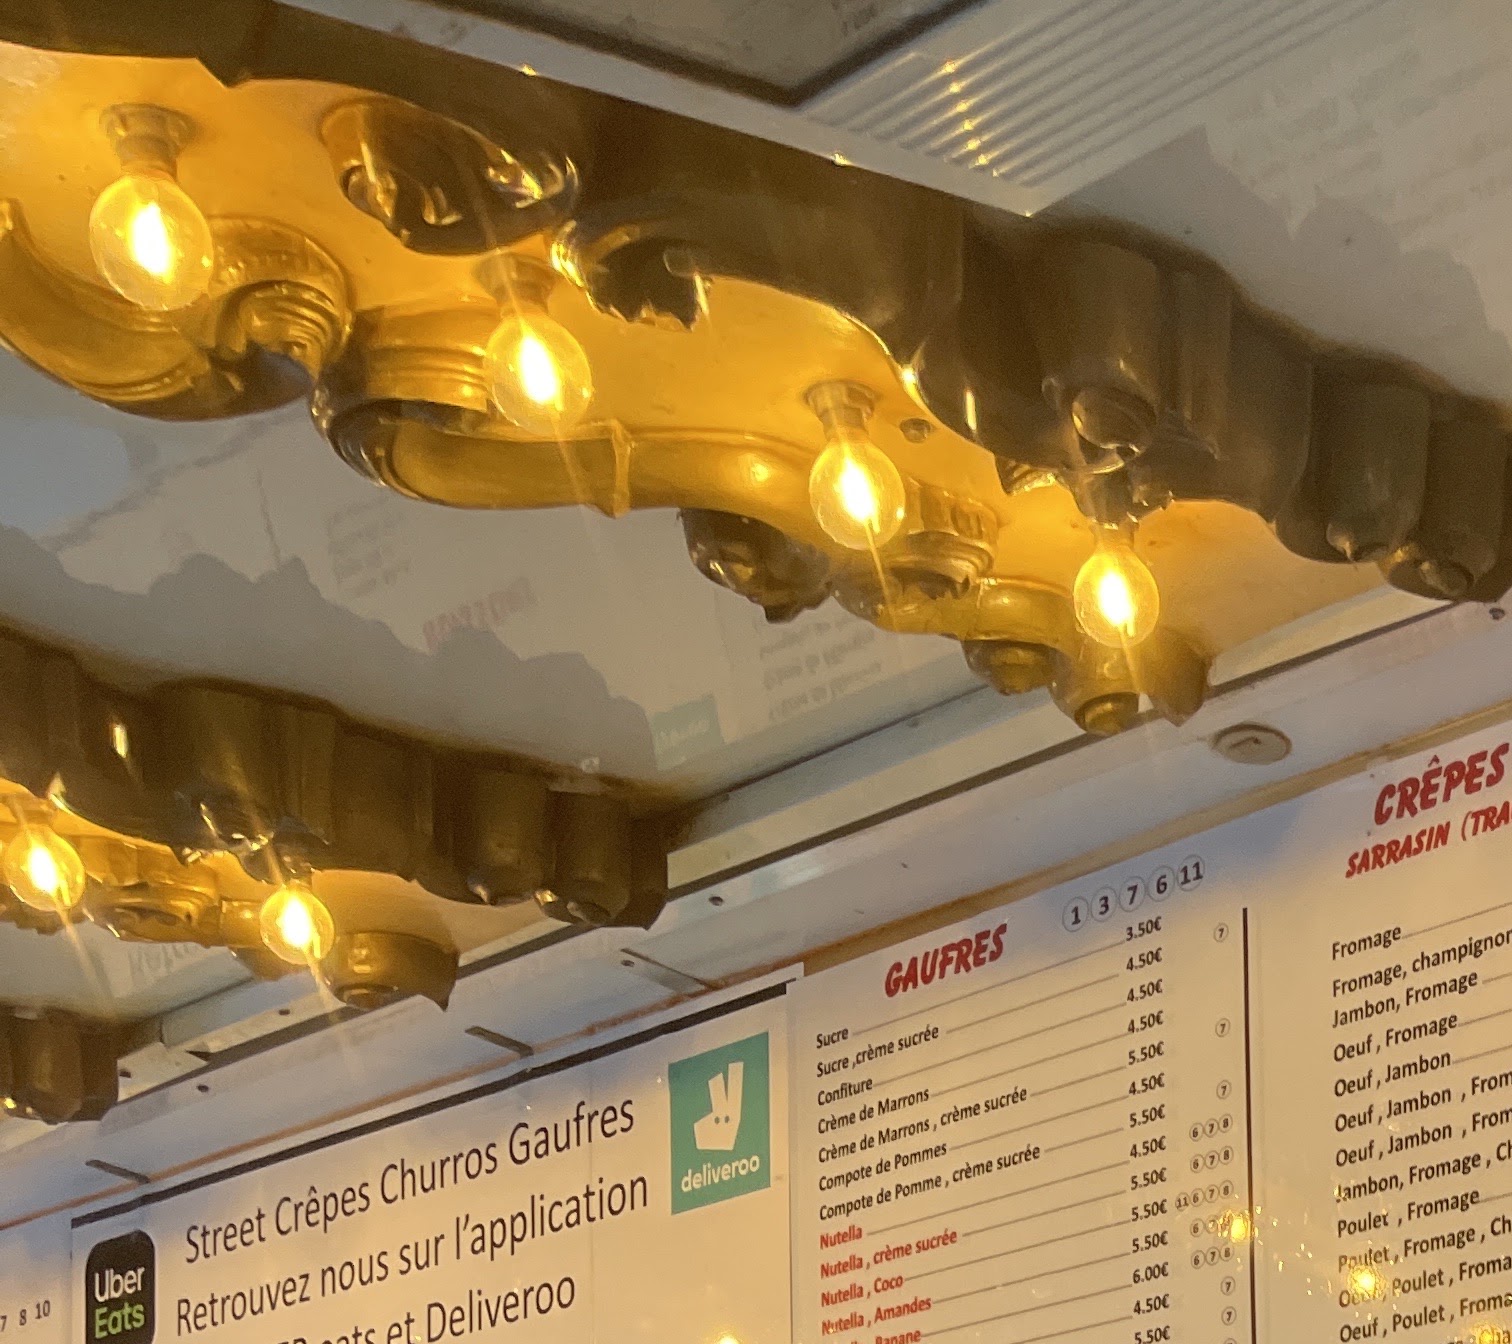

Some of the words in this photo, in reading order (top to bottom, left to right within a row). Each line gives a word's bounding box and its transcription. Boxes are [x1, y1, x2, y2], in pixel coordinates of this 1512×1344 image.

[1374, 736, 1506, 825] CRÊPES
[1346, 824, 1450, 879] SARRASIN
[884, 923, 1008, 997] GAUFRES
[1332, 923, 1402, 961] Fromage
[816, 1026, 849, 1049] Sucre
[1125, 916, 1162, 942] 3.50€
[1332, 962, 1407, 998] Fromage,
[1332, 996, 1401, 1029] Jambon,
[1405, 970, 1478, 1011] Fromage
[817, 1076, 873, 1106] Confiture
[1126, 979, 1163, 1003] 4.50€
[819, 1165, 872, 1192] Compote
[876, 1157, 891, 1175] de
[894, 1141, 947, 1170] Pommes
[1128, 1072, 1165, 1098] 4.50€
[186, 1208, 267, 1264] Street
[275, 1184, 371, 1246] Crêpes
[380, 1141, 498, 1206] Churros
[508, 1098, 636, 1166] Gaufres
[680, 1154, 761, 1194] deliveroo
[94, 1263, 145, 1301] Uber
[177, 1272, 311, 1337] Retrouvez
[320, 1251, 389, 1304] nous
[398, 1230, 445, 1277] sur
[454, 1174, 649, 1264] l'application
[95, 1304, 146, 1340] Eats
[426, 1272, 575, 1344] Deliveroo
